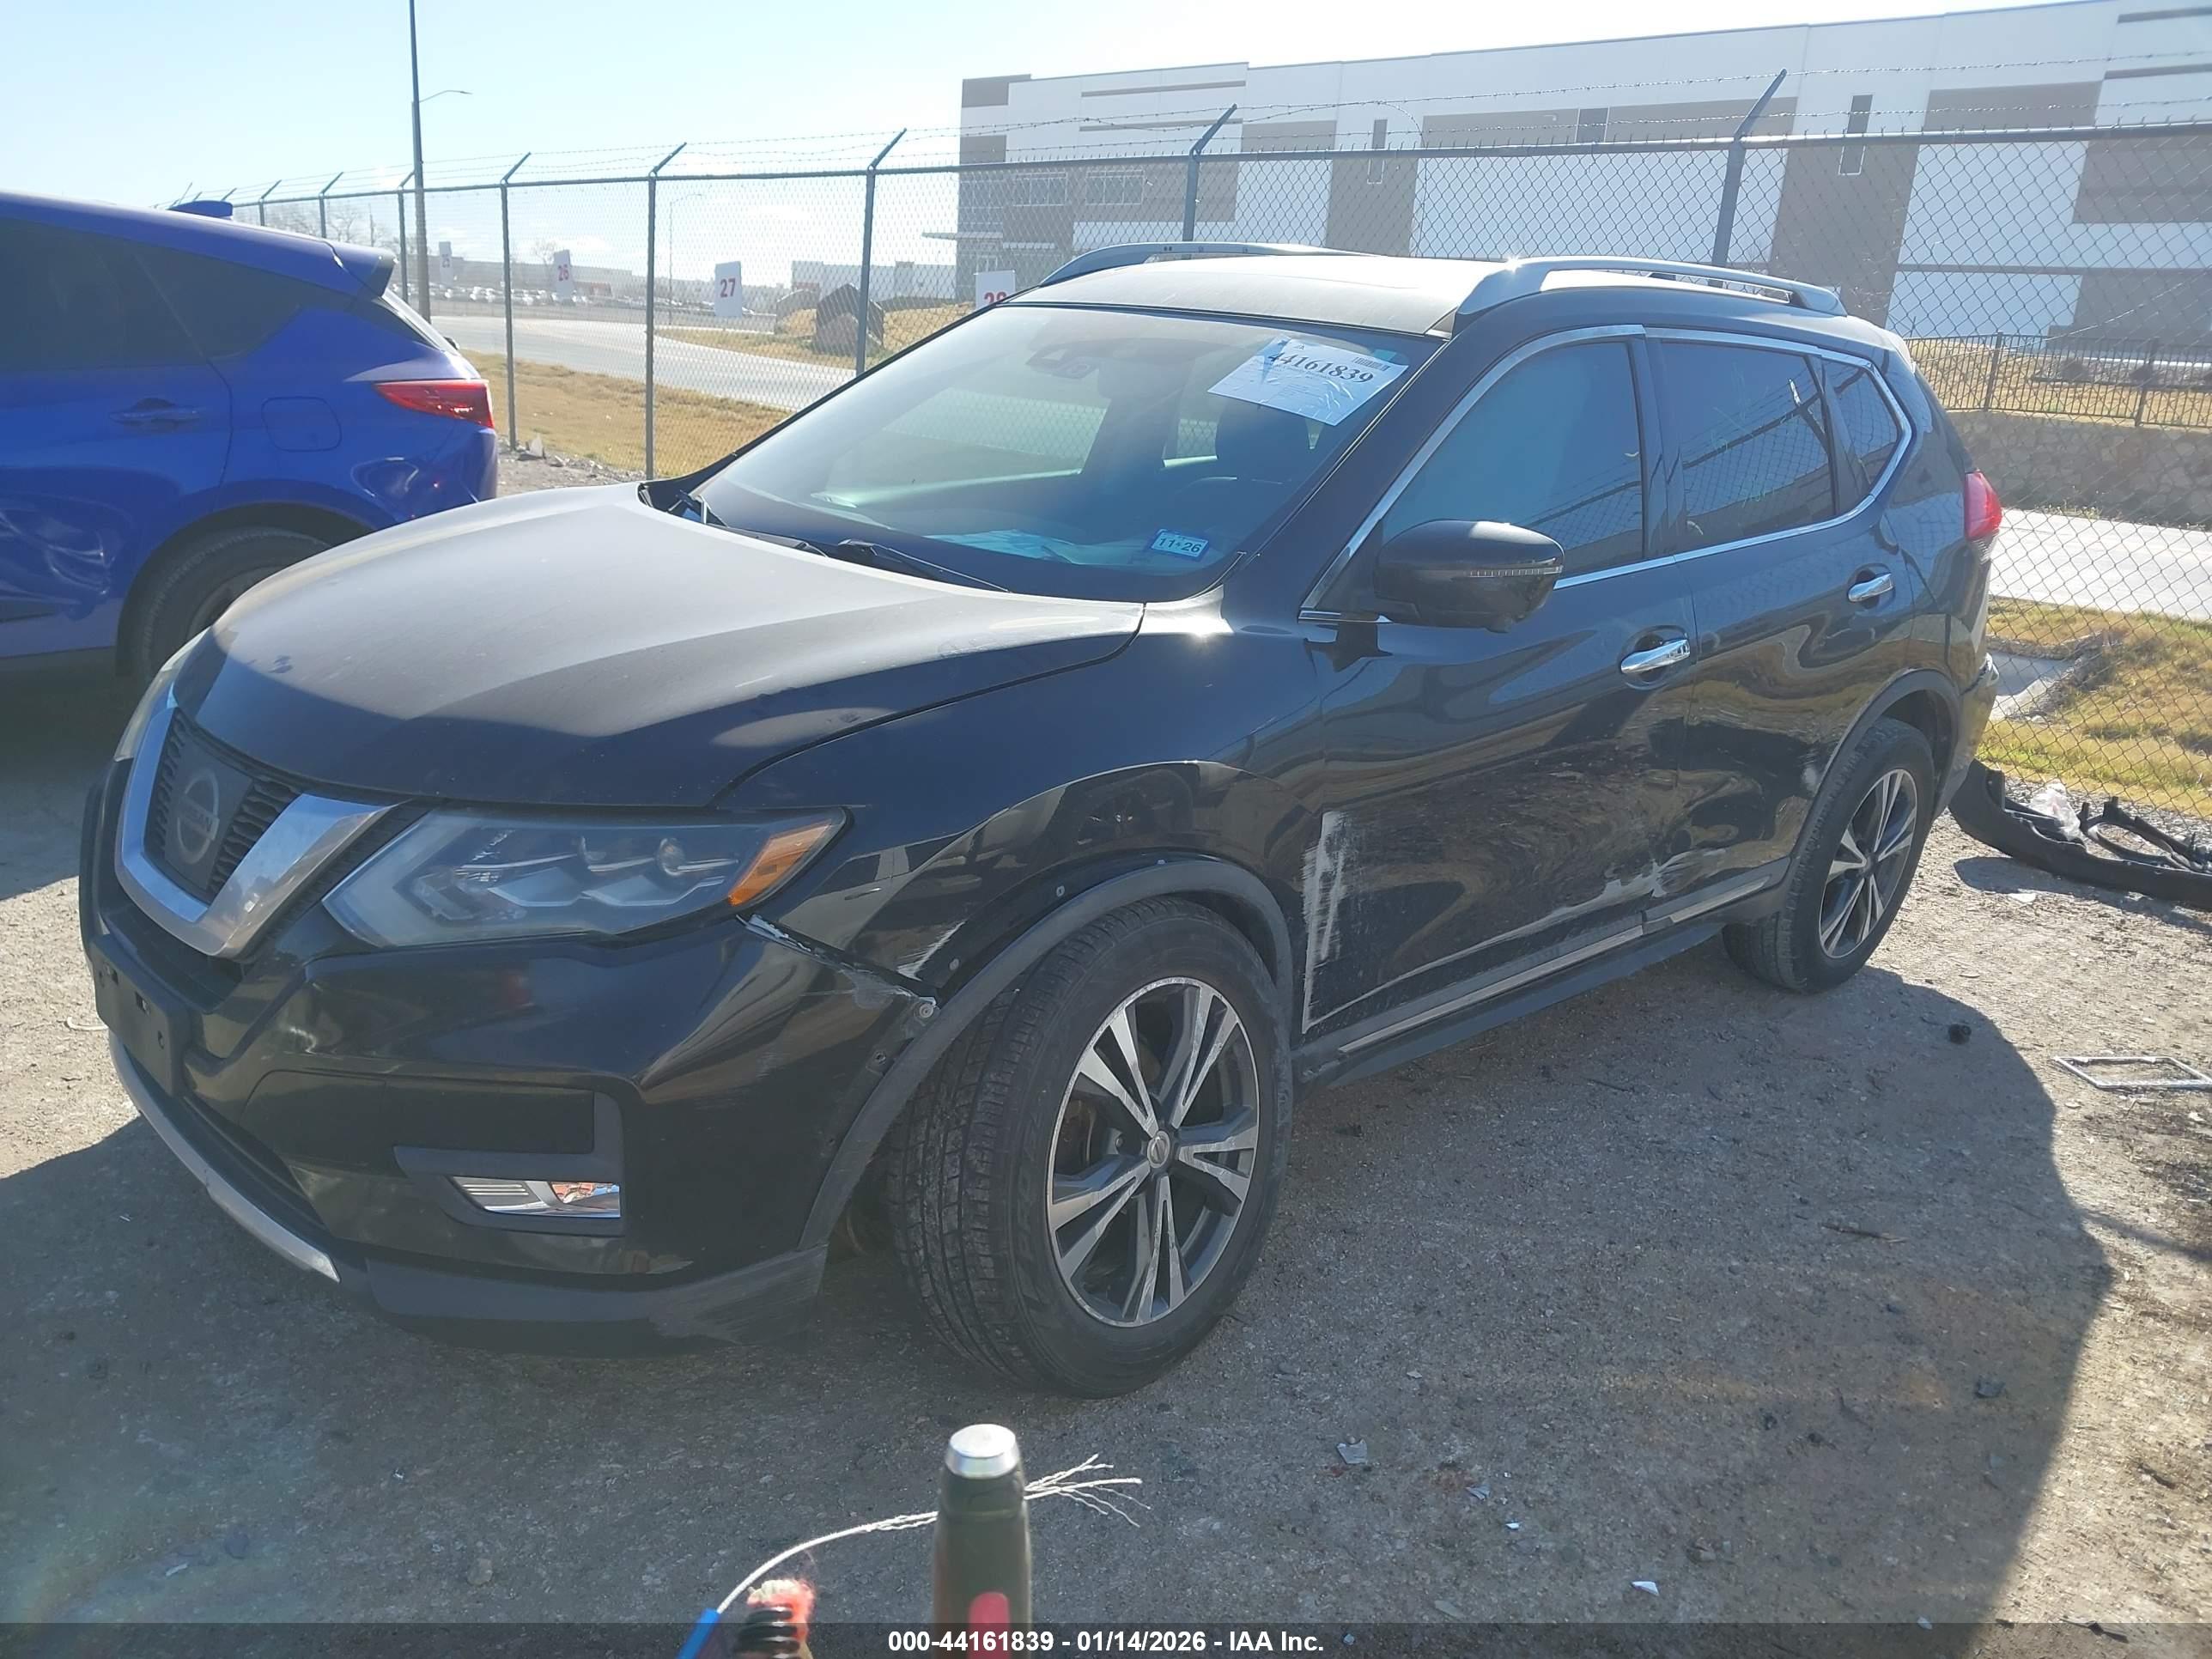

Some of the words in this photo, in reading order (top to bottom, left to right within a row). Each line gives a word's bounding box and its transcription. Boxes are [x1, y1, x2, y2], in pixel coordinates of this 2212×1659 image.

[558, 264, 569, 281] 26
[720, 277, 736, 298] 27
[1268, 352, 1374, 383] 44161839
[1159, 538, 1176, 548] 11
[1181, 542, 1202, 553] 26
